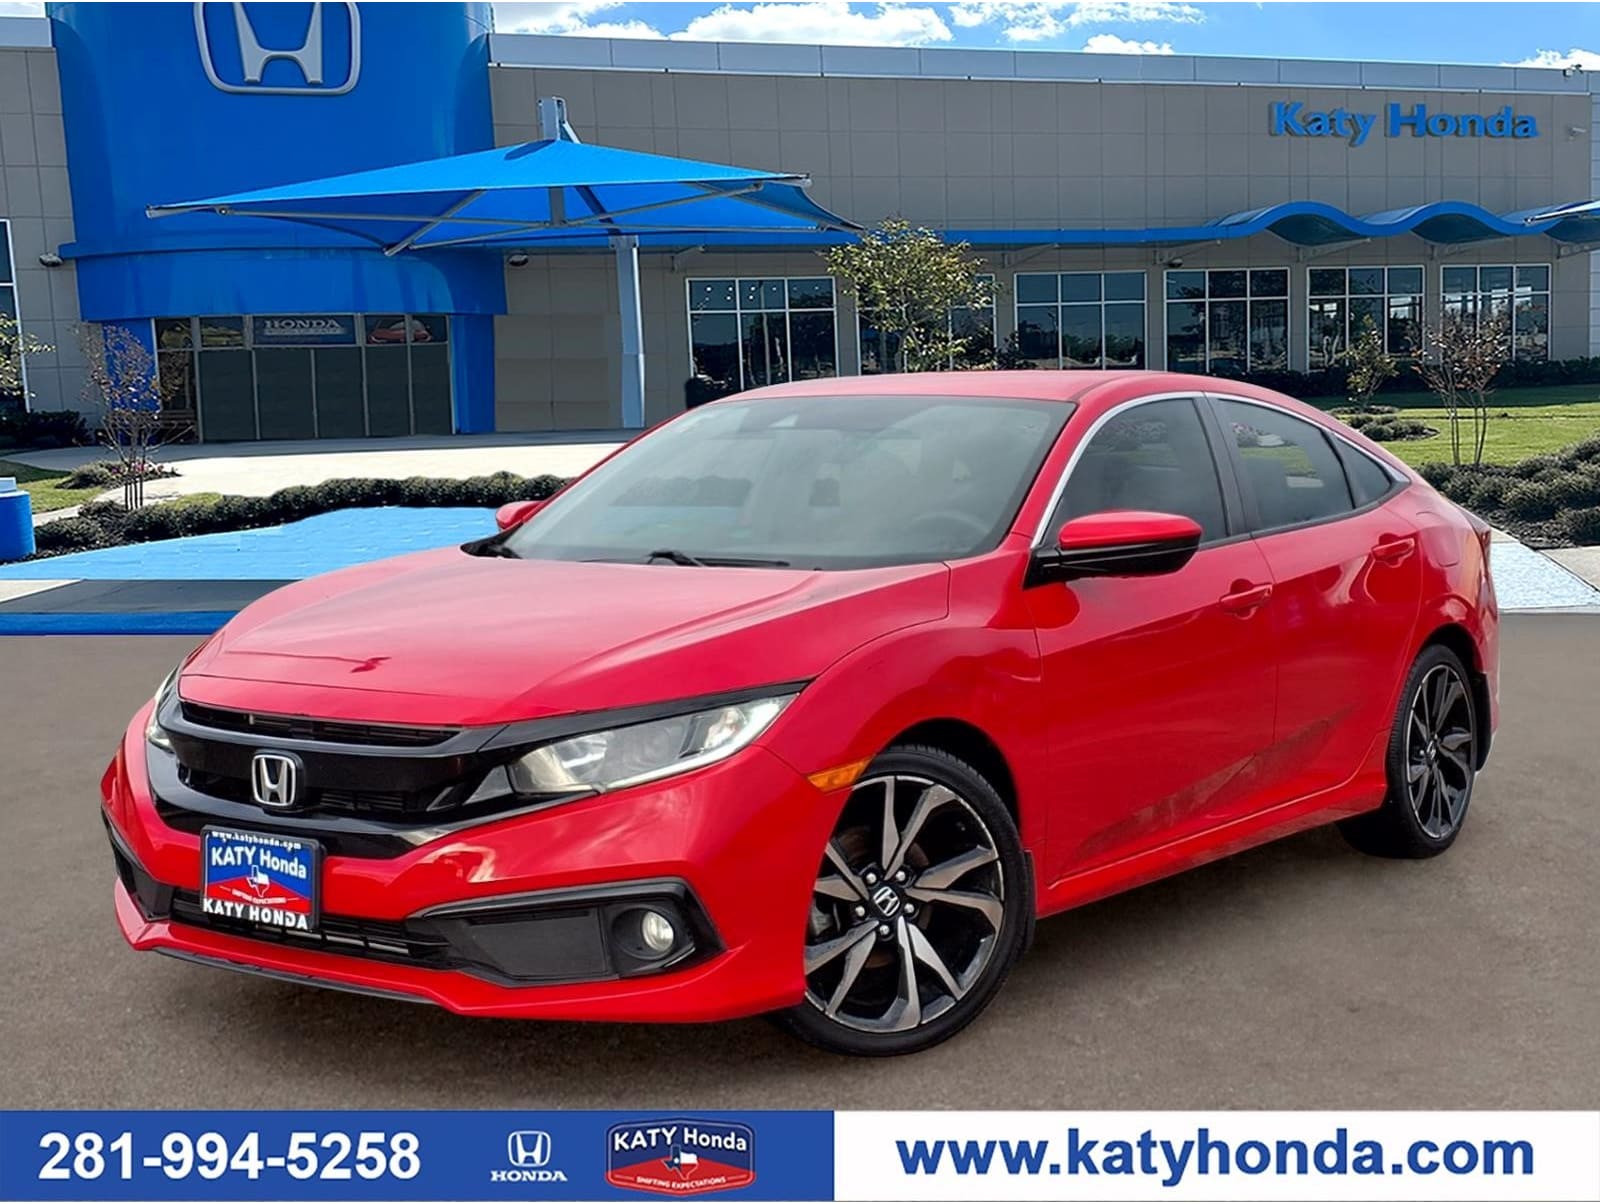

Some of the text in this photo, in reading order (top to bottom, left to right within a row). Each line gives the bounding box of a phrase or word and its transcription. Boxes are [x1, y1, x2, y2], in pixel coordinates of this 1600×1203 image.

[1271, 102, 1539, 146] Katy Honda
[264, 318, 341, 329] HONDA
[211, 846, 307, 879] KATY Honda
[203, 897, 308, 930] KATY HONDA
